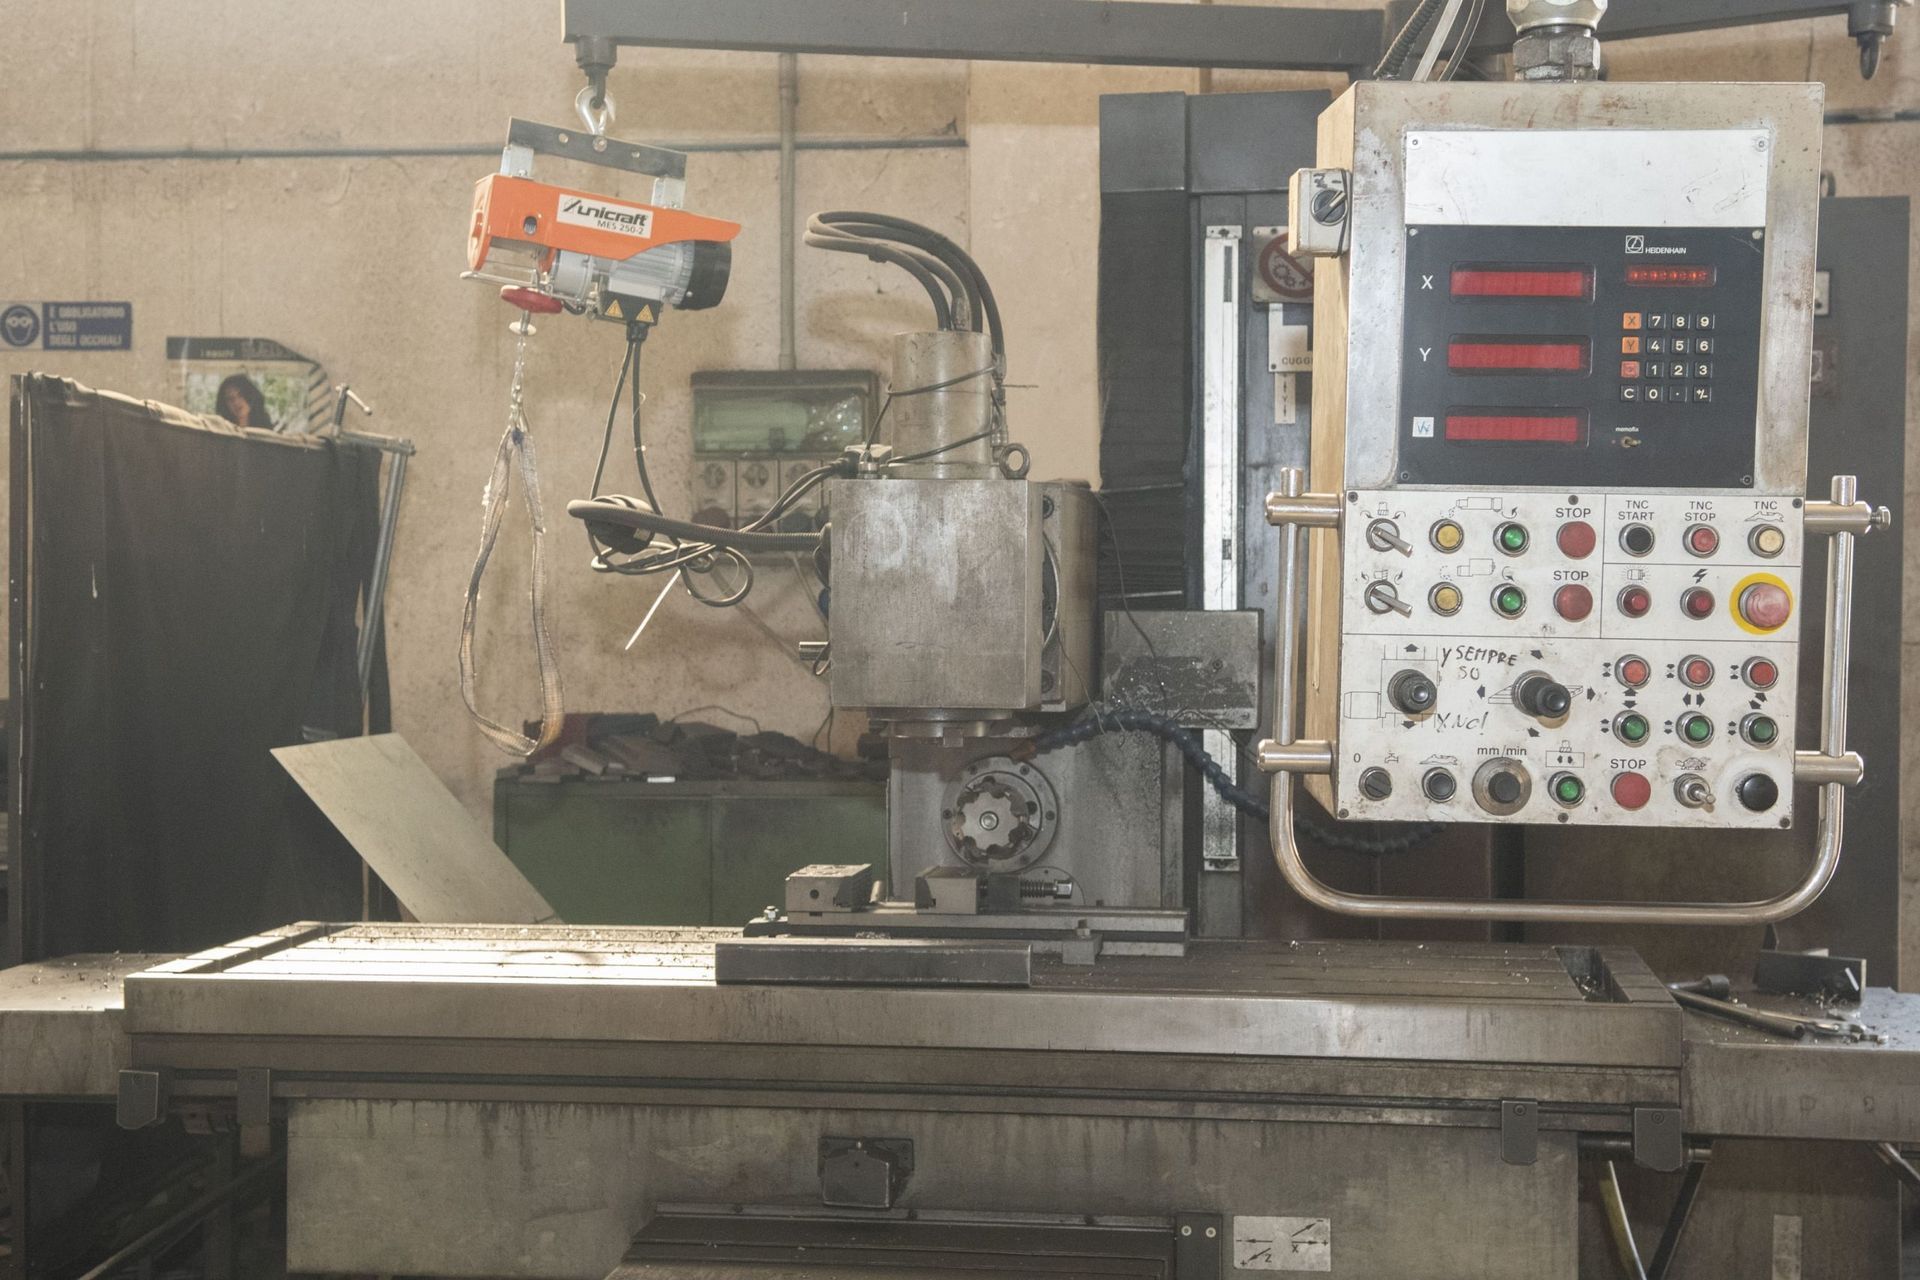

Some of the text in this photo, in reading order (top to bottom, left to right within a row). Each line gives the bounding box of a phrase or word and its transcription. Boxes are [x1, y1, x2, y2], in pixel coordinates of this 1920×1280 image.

[597, 219, 617, 231] MES
[1645, 247, 1687, 255] HEIDENHAIN
[1421, 274, 1434, 290] X
[1652, 315, 1661, 327] 7
[1676, 316, 1685, 327] 8
[1700, 316, 1710, 327] 9
[1651, 340, 1660, 351] 4
[1675, 340, 1684, 351] 5
[1699, 340, 1709, 351] 6
[1419, 347, 1432, 362] Y
[1281, 356, 1313, 366] CUGG
[1651, 364, 1658, 376] 1
[1674, 364, 1683, 376] 2
[1699, 364, 1708, 376] 3
[1623, 388, 1635, 399] C
[1625, 500, 1649, 510] TNC
[1689, 501, 1713, 511] TNC
[1753, 500, 1778, 510] TNC
[1555, 507, 1591, 519] STOP
[1618, 511, 1656, 521] START
[1684, 511, 1717, 522] STOP
[1553, 570, 1590, 581] STOP
[1455, 645, 1518, 666] SEMPRE
[1477, 745, 1527, 756] mm/min
[1610, 758, 1648, 769] STOP
